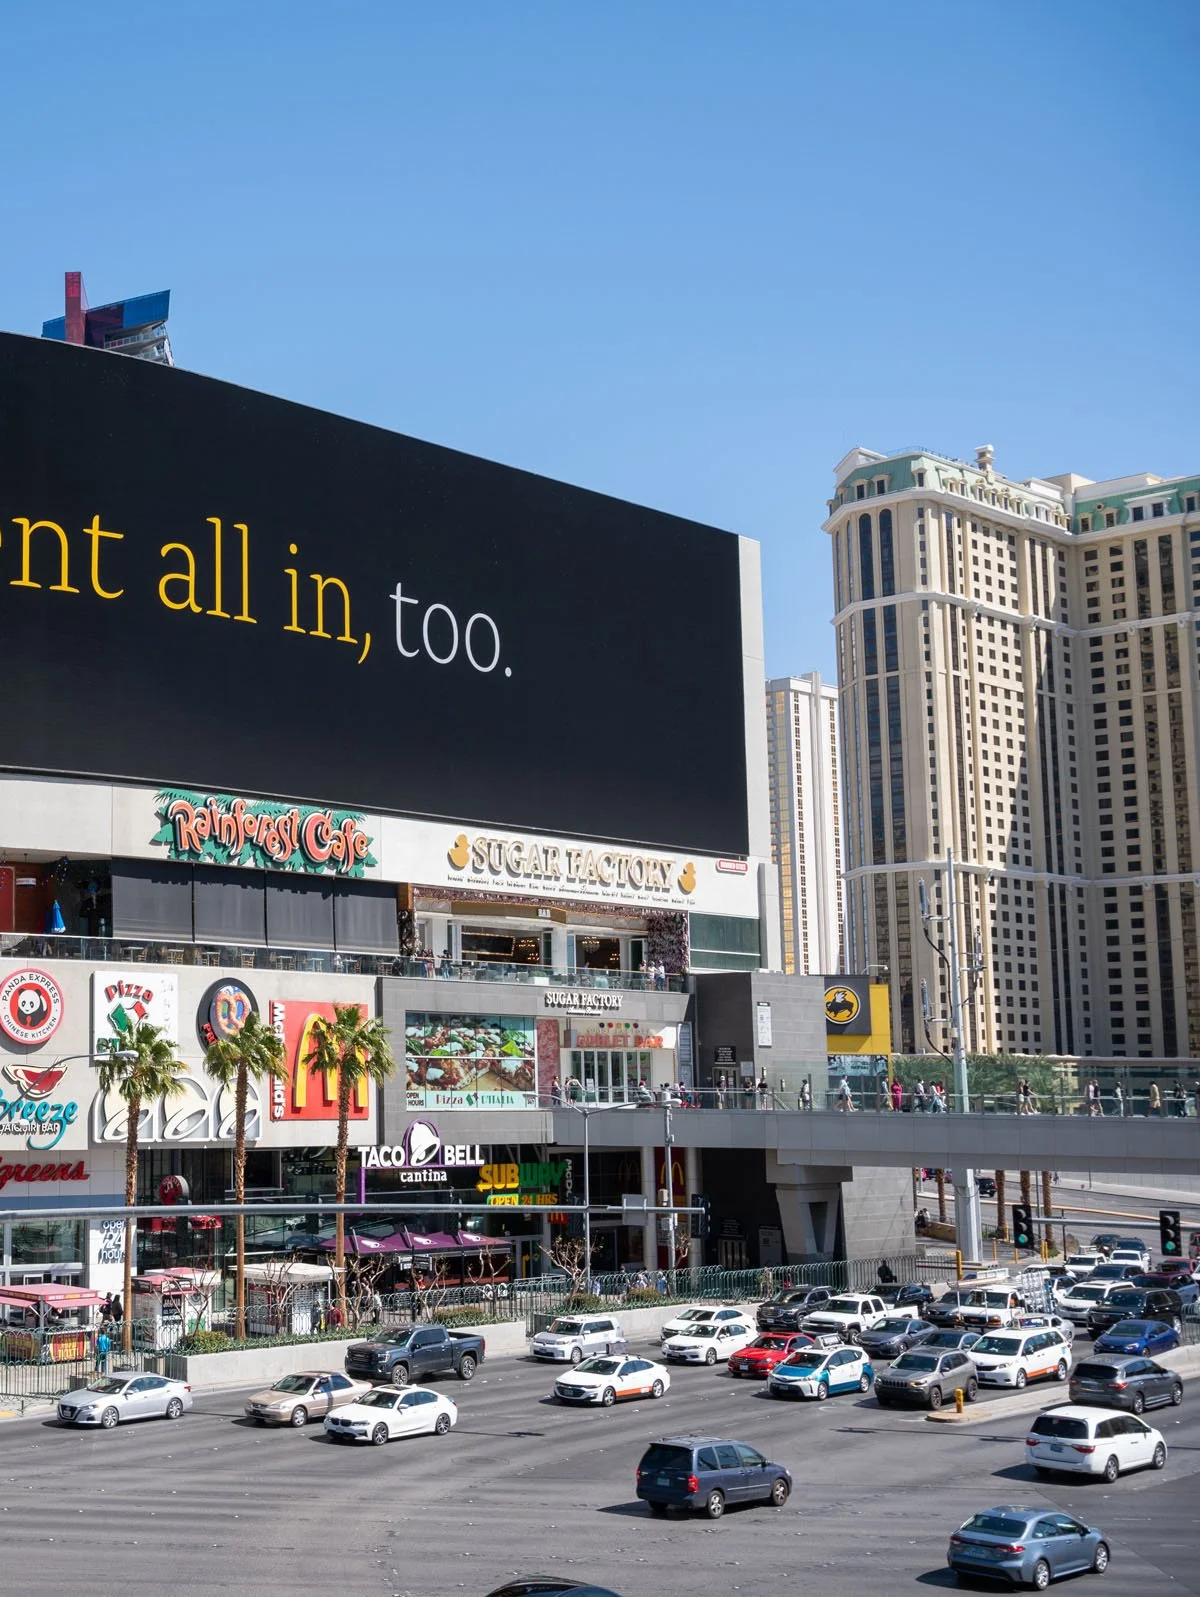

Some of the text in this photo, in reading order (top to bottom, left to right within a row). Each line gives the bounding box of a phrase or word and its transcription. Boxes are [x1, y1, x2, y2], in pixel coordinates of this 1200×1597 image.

[159, 518, 257, 624] all
[283, 544, 371, 665] in,
[390, 583, 512, 678] too.
[169, 797, 300, 862] Rainforest
[472, 837, 563, 878] SUGAR
[566, 848, 677, 889] FACTORY
[2, 973, 60, 1004] PANDA EXPRESS
[105, 979, 154, 1003] Pizza
[546, 991, 623, 1007] SUGAR FACTORY
[3, 1014, 57, 1039] CHINESE KITCHEN
[436, 1094, 463, 1105] Pizza
[357, 1145, 485, 1168] TACO BELL
[400, 1169, 448, 1183] cantina
[475, 1161, 568, 1192] SUBWAY
[489, 1196, 518, 1206] OPEN
[537, 1194, 558, 1205] HRS
